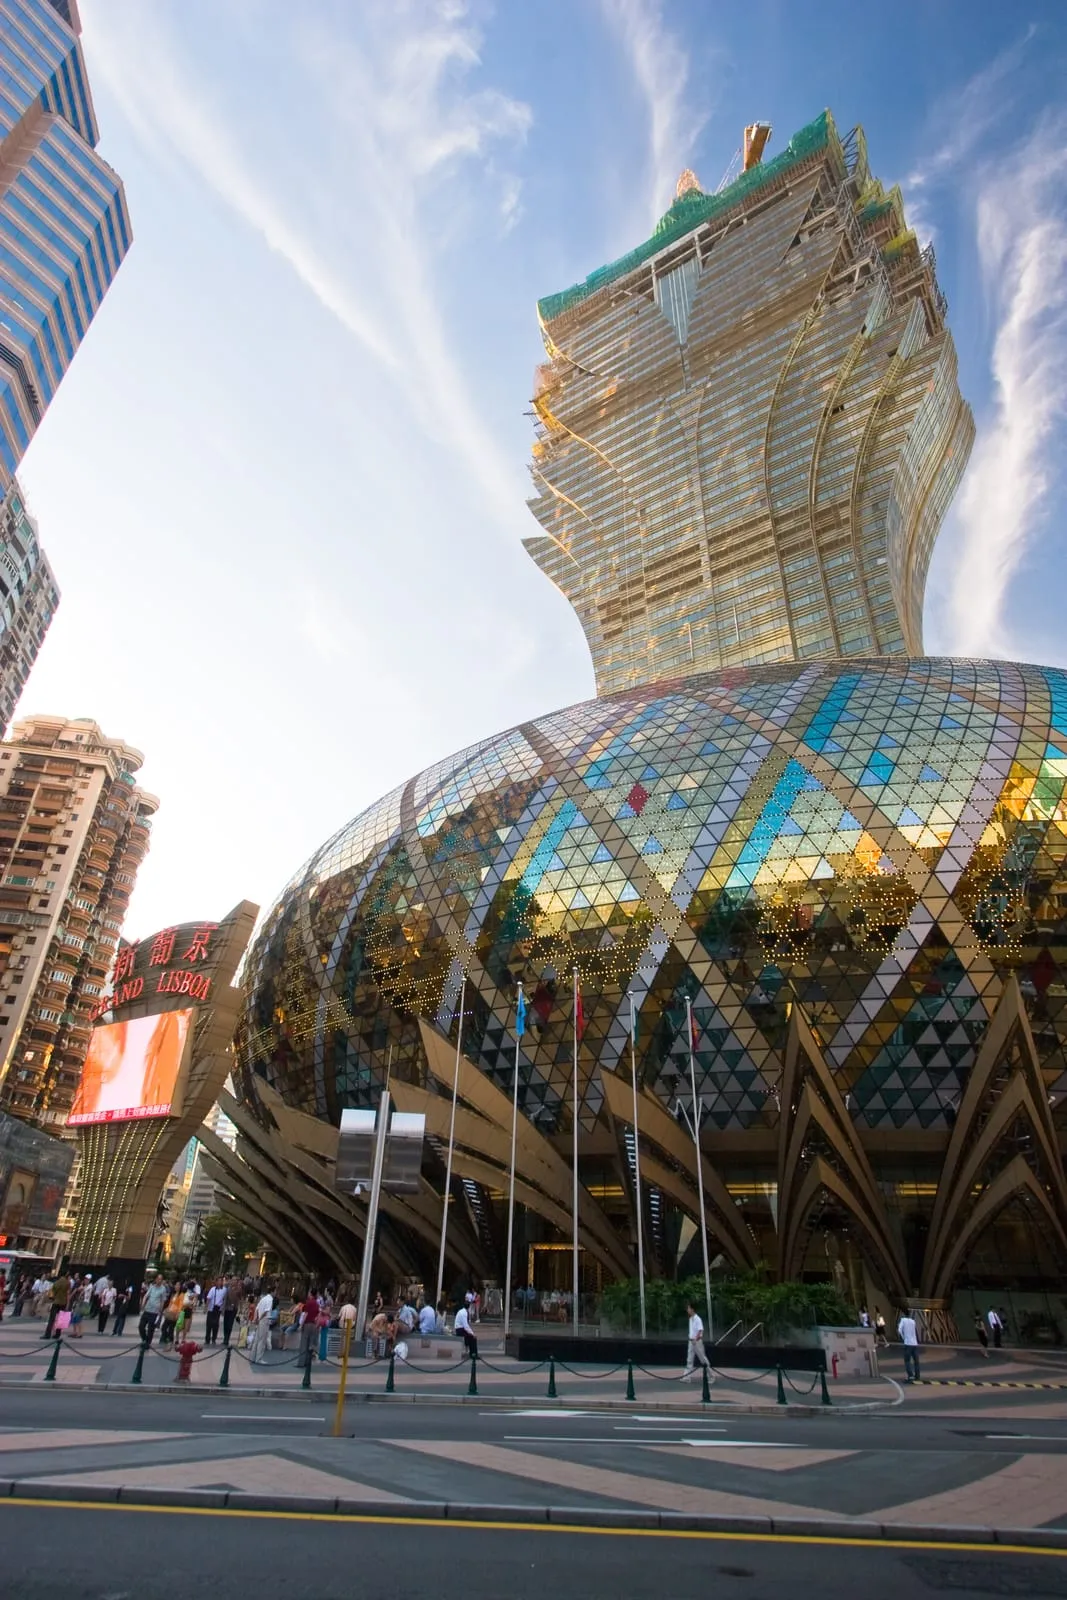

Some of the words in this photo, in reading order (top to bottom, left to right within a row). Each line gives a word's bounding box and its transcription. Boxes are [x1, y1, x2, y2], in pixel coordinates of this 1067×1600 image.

[111, 921, 218, 984] 新葡京
[88, 977, 144, 1021] GRAND
[156, 970, 211, 1000] LISBOA
